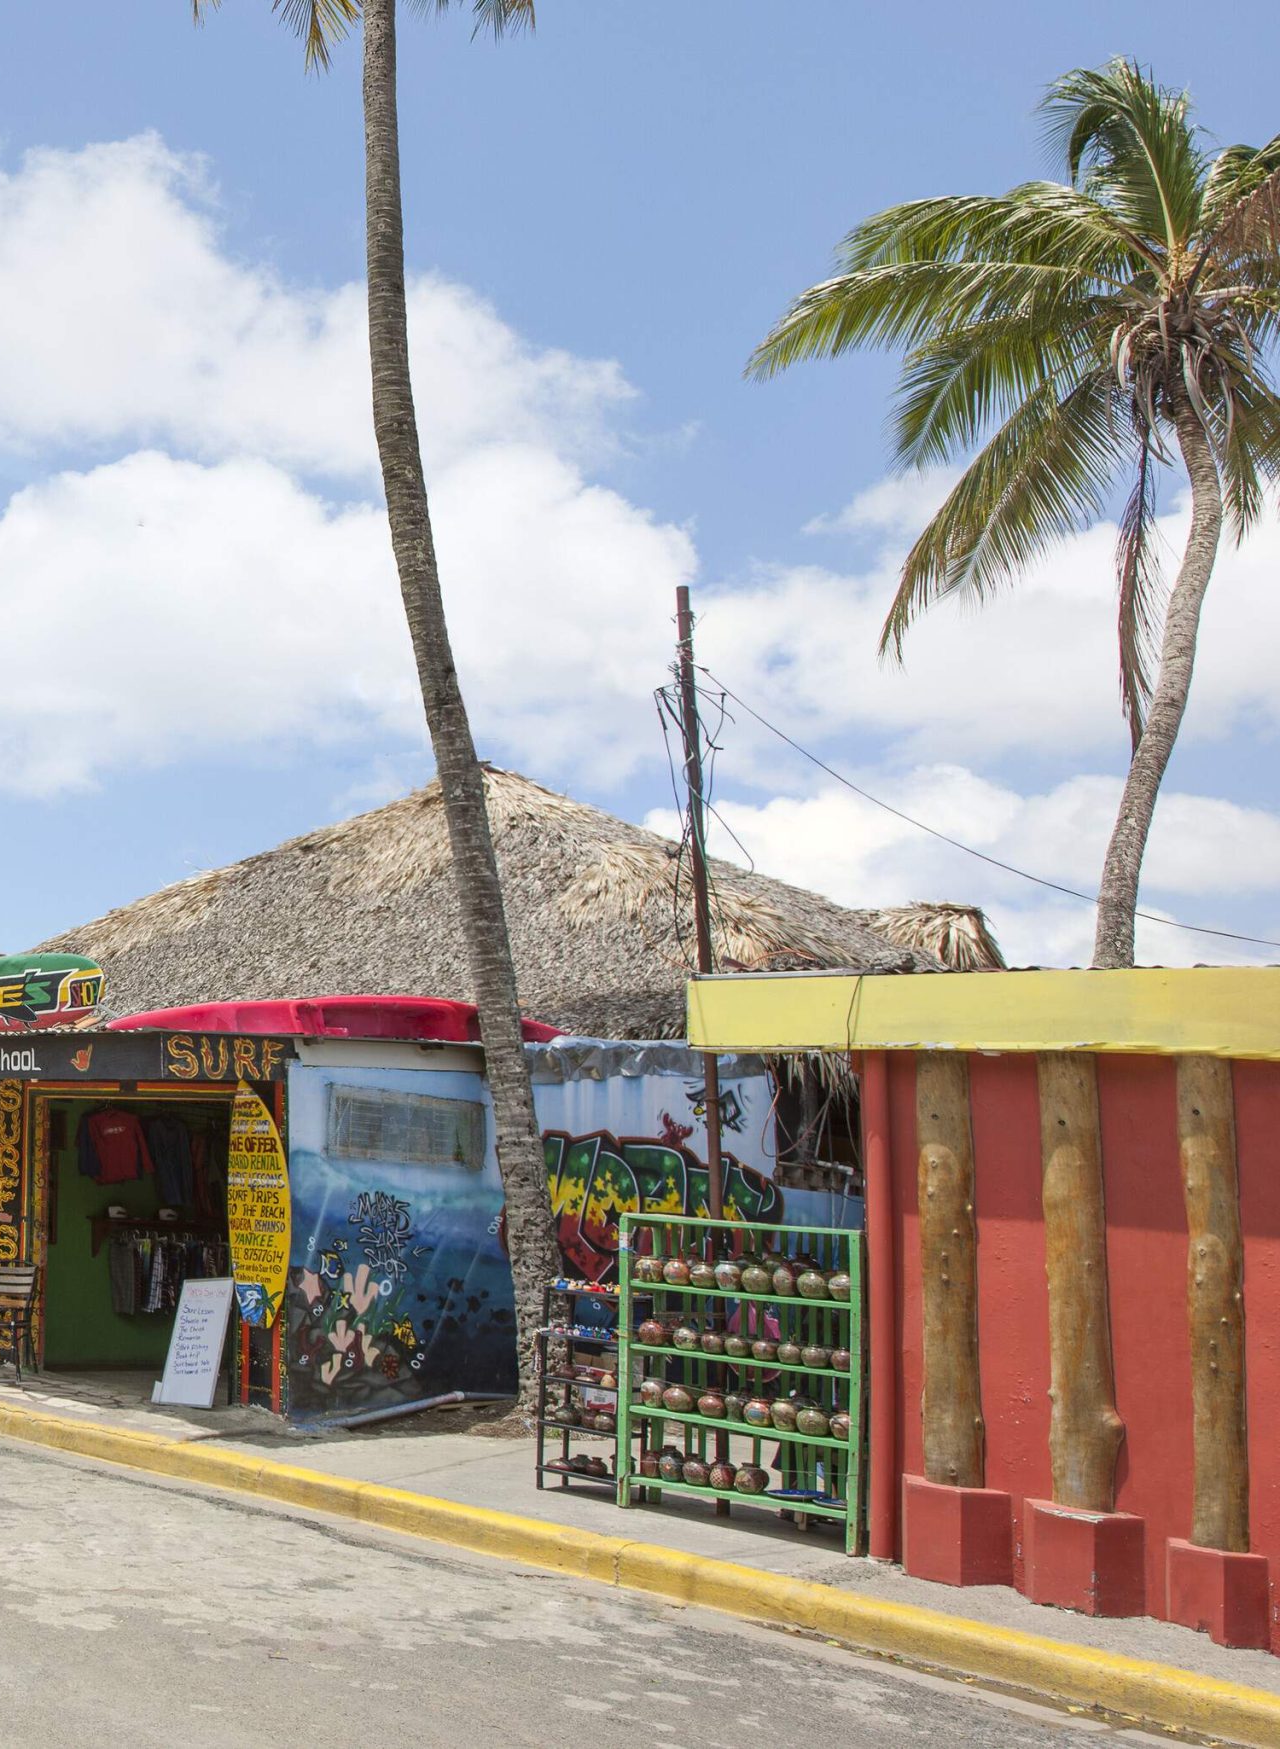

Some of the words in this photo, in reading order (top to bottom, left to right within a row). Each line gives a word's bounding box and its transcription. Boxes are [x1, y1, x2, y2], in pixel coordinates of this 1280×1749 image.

[70, 980, 99, 1007] SHOP
[167, 1035, 286, 1080] SURF
[245, 1136, 279, 1154] OFFER
[251, 1154, 281, 1171] RENTAL
[251, 1188, 280, 1204] TRIPS
[243, 1204, 258, 1217] THE
[261, 1205, 285, 1219] BEACH
[244, 1247, 284, 1263] 87577614
